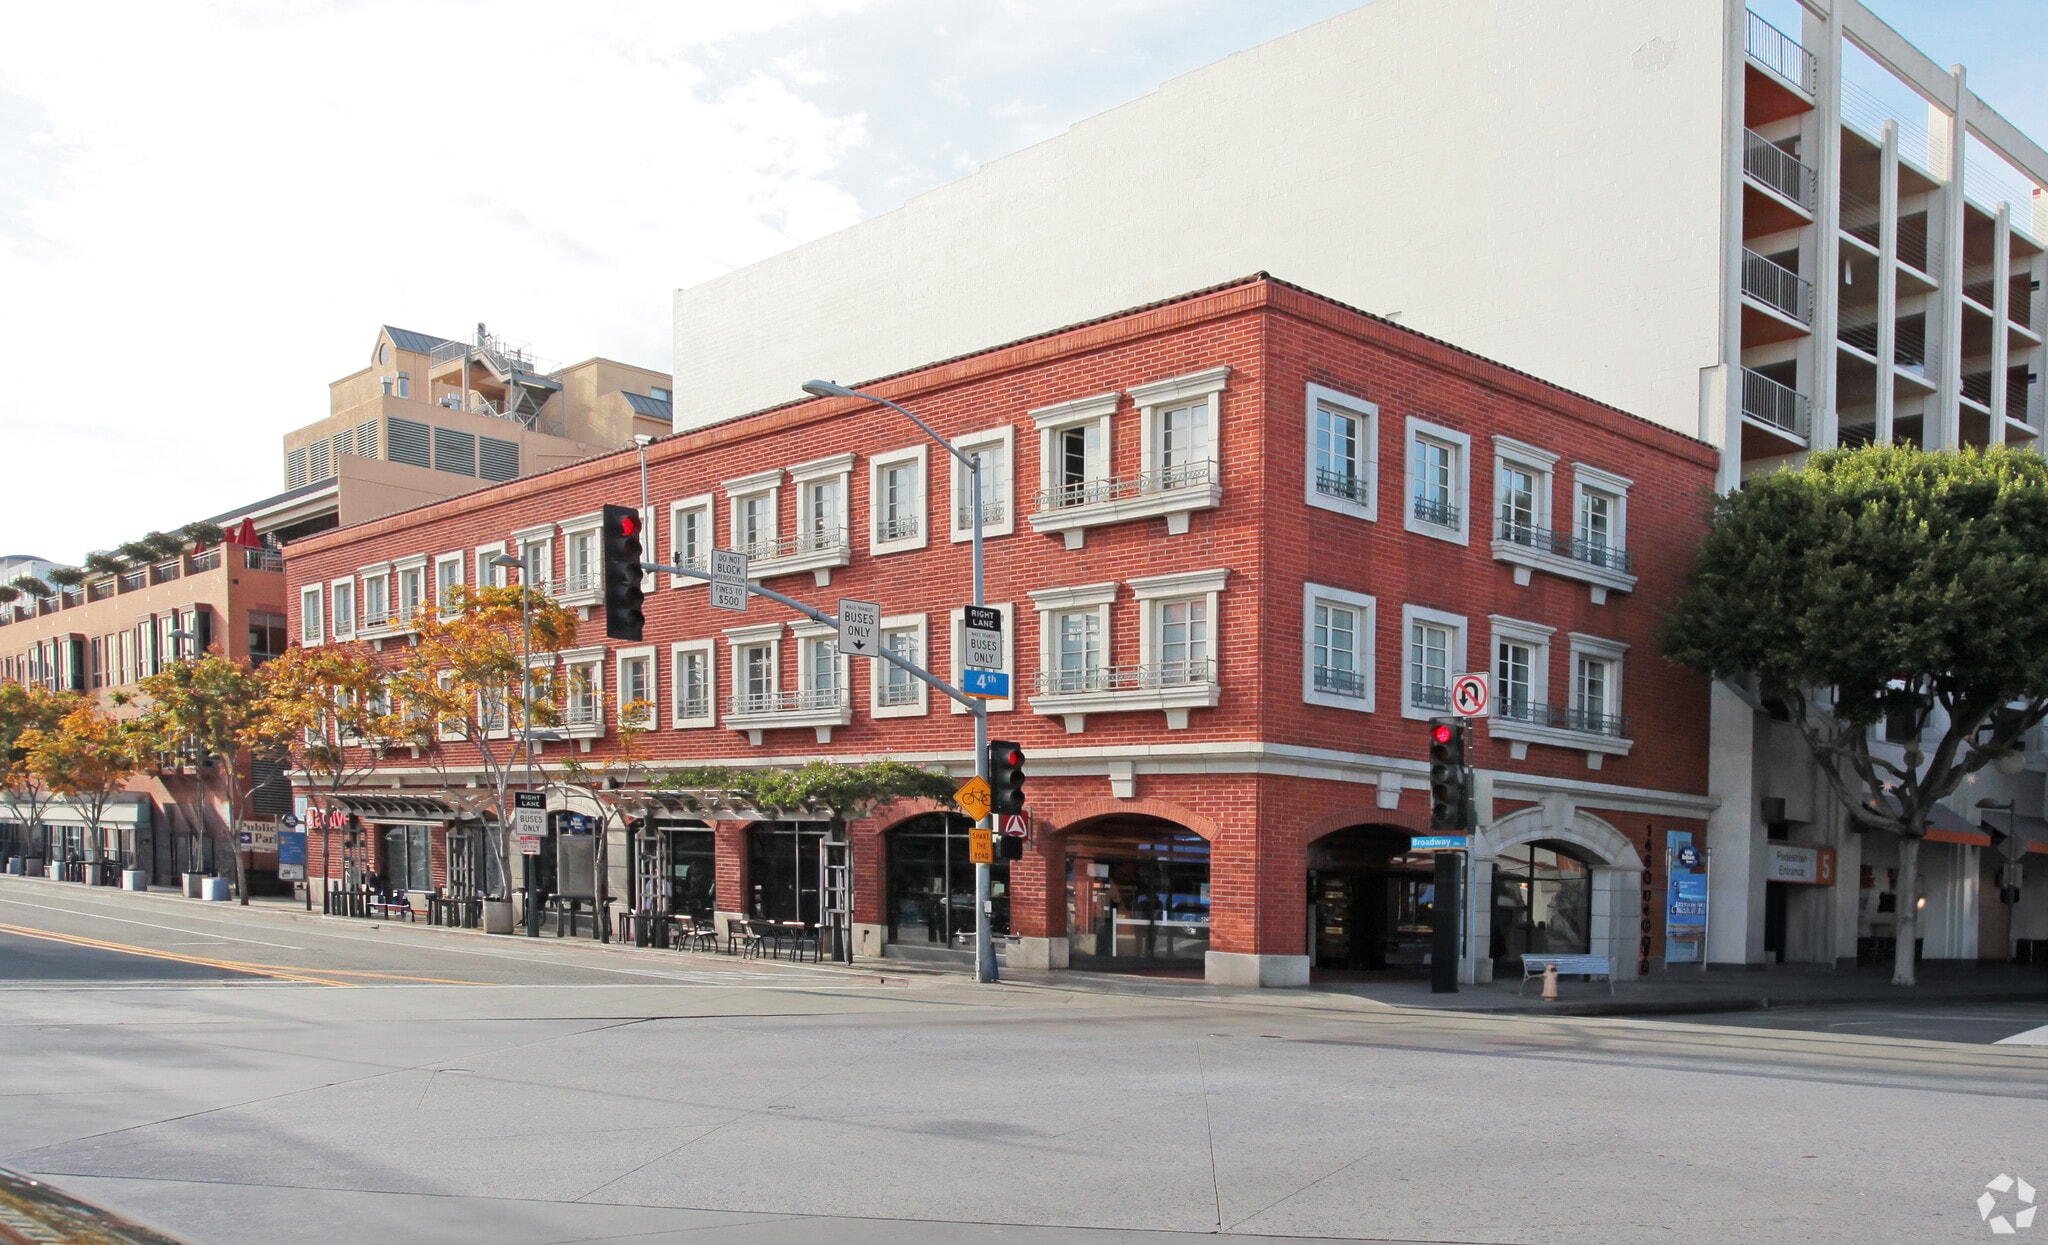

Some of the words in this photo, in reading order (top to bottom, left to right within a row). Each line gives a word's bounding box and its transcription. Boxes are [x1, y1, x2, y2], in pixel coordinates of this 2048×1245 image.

[718, 554, 727, 563] DO
[729, 556, 741, 565] NOT
[717, 563, 741, 575] BLOCK
[714, 573, 745, 583] INTERSECTION
[715, 585, 733, 595] FINES
[735, 588, 743, 598] TO
[719, 595, 739, 606] $500
[844, 611, 874, 625] BUSES
[971, 609, 995, 619] RIGHT
[972, 618, 994, 628] LANE
[848, 625, 870, 638] ONLY
[971, 639, 997, 651] BUSES
[974, 652, 994, 664] ONLY
[976, 674, 997, 689] 4th
[520, 815, 543, 824] BUSES
[523, 824, 541, 832] ONLY
[972, 832, 990, 840] SHARE
[1412, 838, 1451, 848] Broadway
[974, 852, 989, 860] ROAD
[1777, 851, 1808, 864] Pedestrian
[1779, 865, 1805, 877] Entrance
